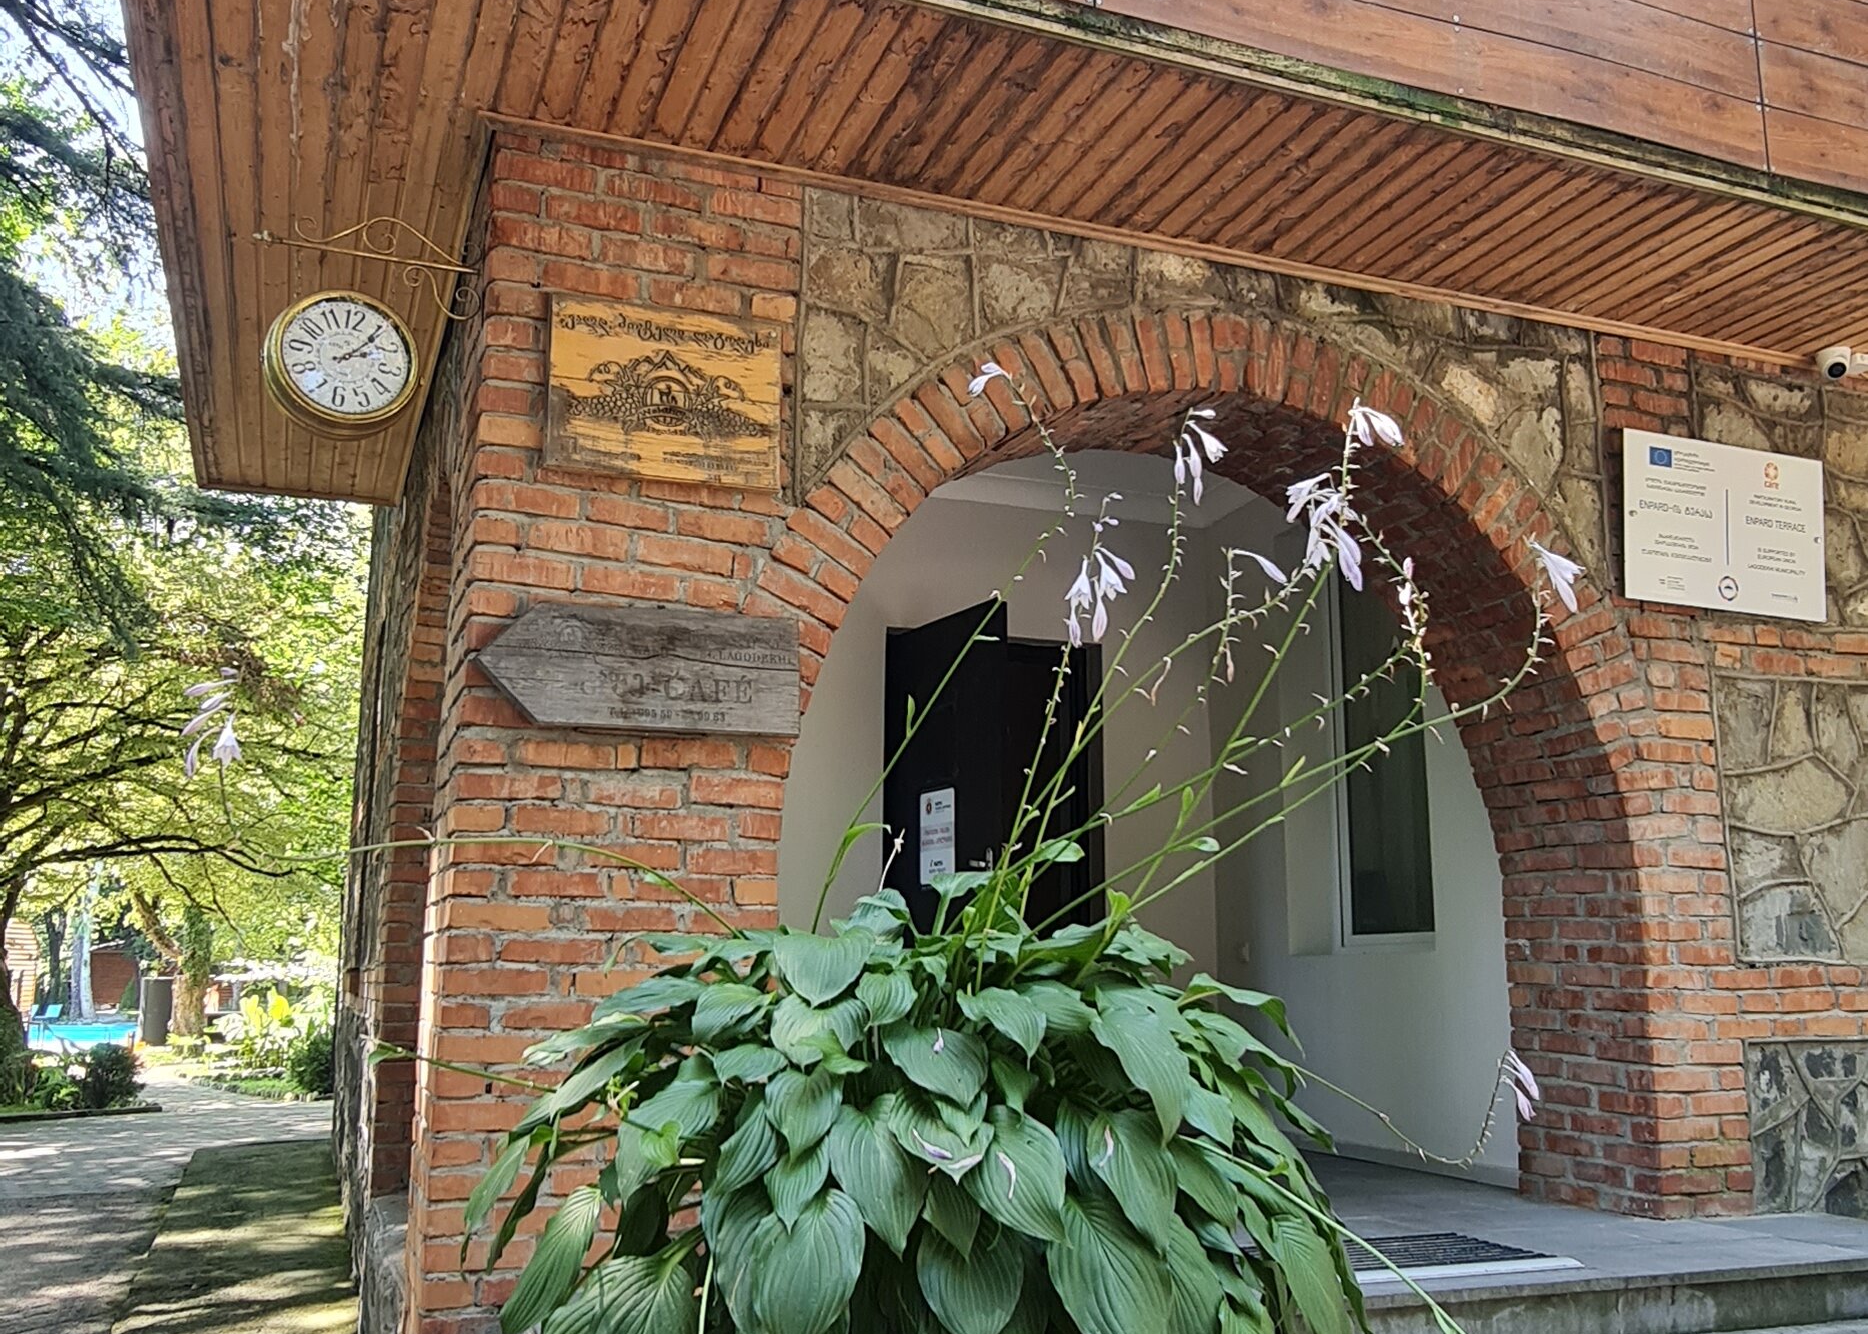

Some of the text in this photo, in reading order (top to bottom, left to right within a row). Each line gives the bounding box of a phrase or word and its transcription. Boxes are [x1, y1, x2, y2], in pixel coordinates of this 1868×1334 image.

[300, 317, 324, 340] 10
[320, 309, 341, 330] 11
[344, 309, 366, 332] 12
[289, 338, 314, 354] 9
[375, 341, 399, 354] 2
[291, 360, 316, 375] 8
[378, 362, 402, 377] 3
[371, 377, 391, 396] 4
[331, 387, 345, 408] 6
[353, 385, 371, 408] 5
[1775, 519, 1807, 534] TERRACE
